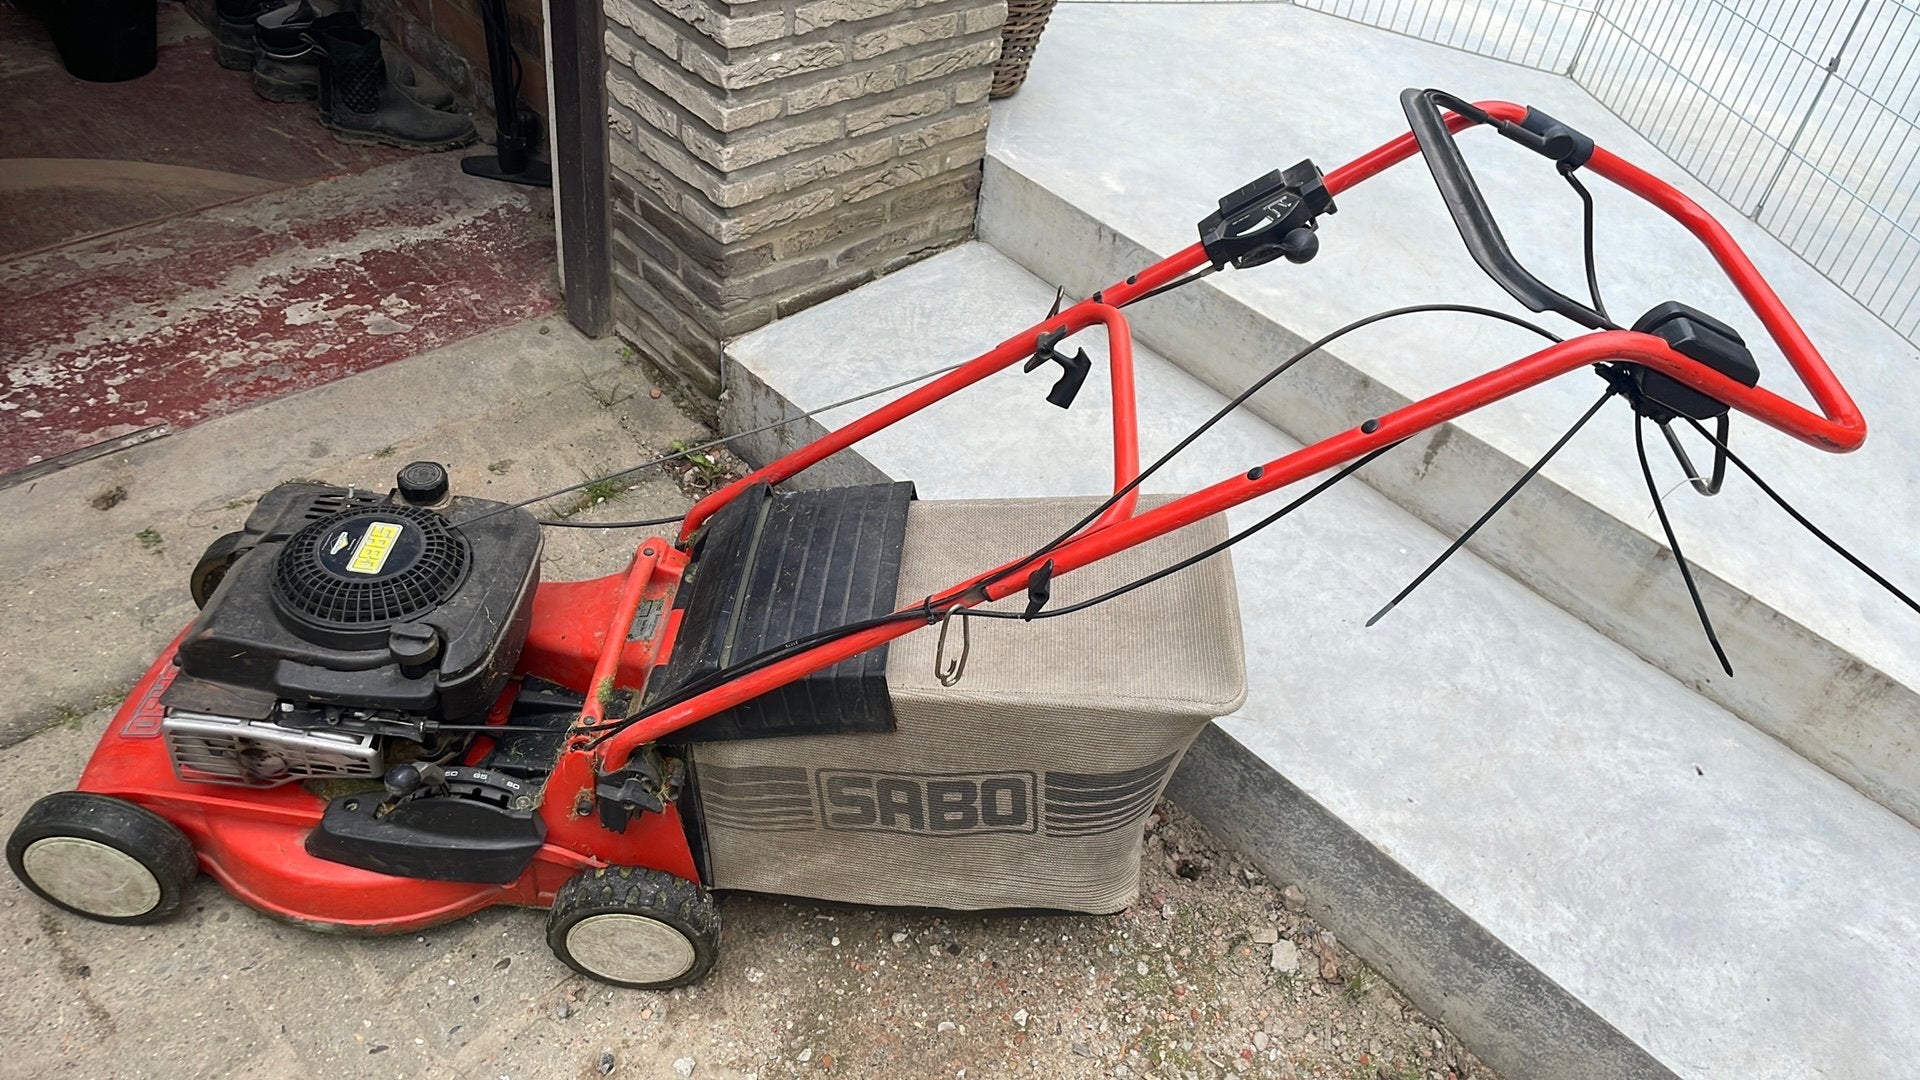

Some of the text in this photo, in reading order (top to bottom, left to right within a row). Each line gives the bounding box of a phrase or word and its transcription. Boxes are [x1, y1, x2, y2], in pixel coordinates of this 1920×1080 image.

[352, 525, 400, 571] SABO
[472, 771, 488, 780] 65
[506, 780, 521, 790] 80
[826, 776, 1028, 831] SABO
